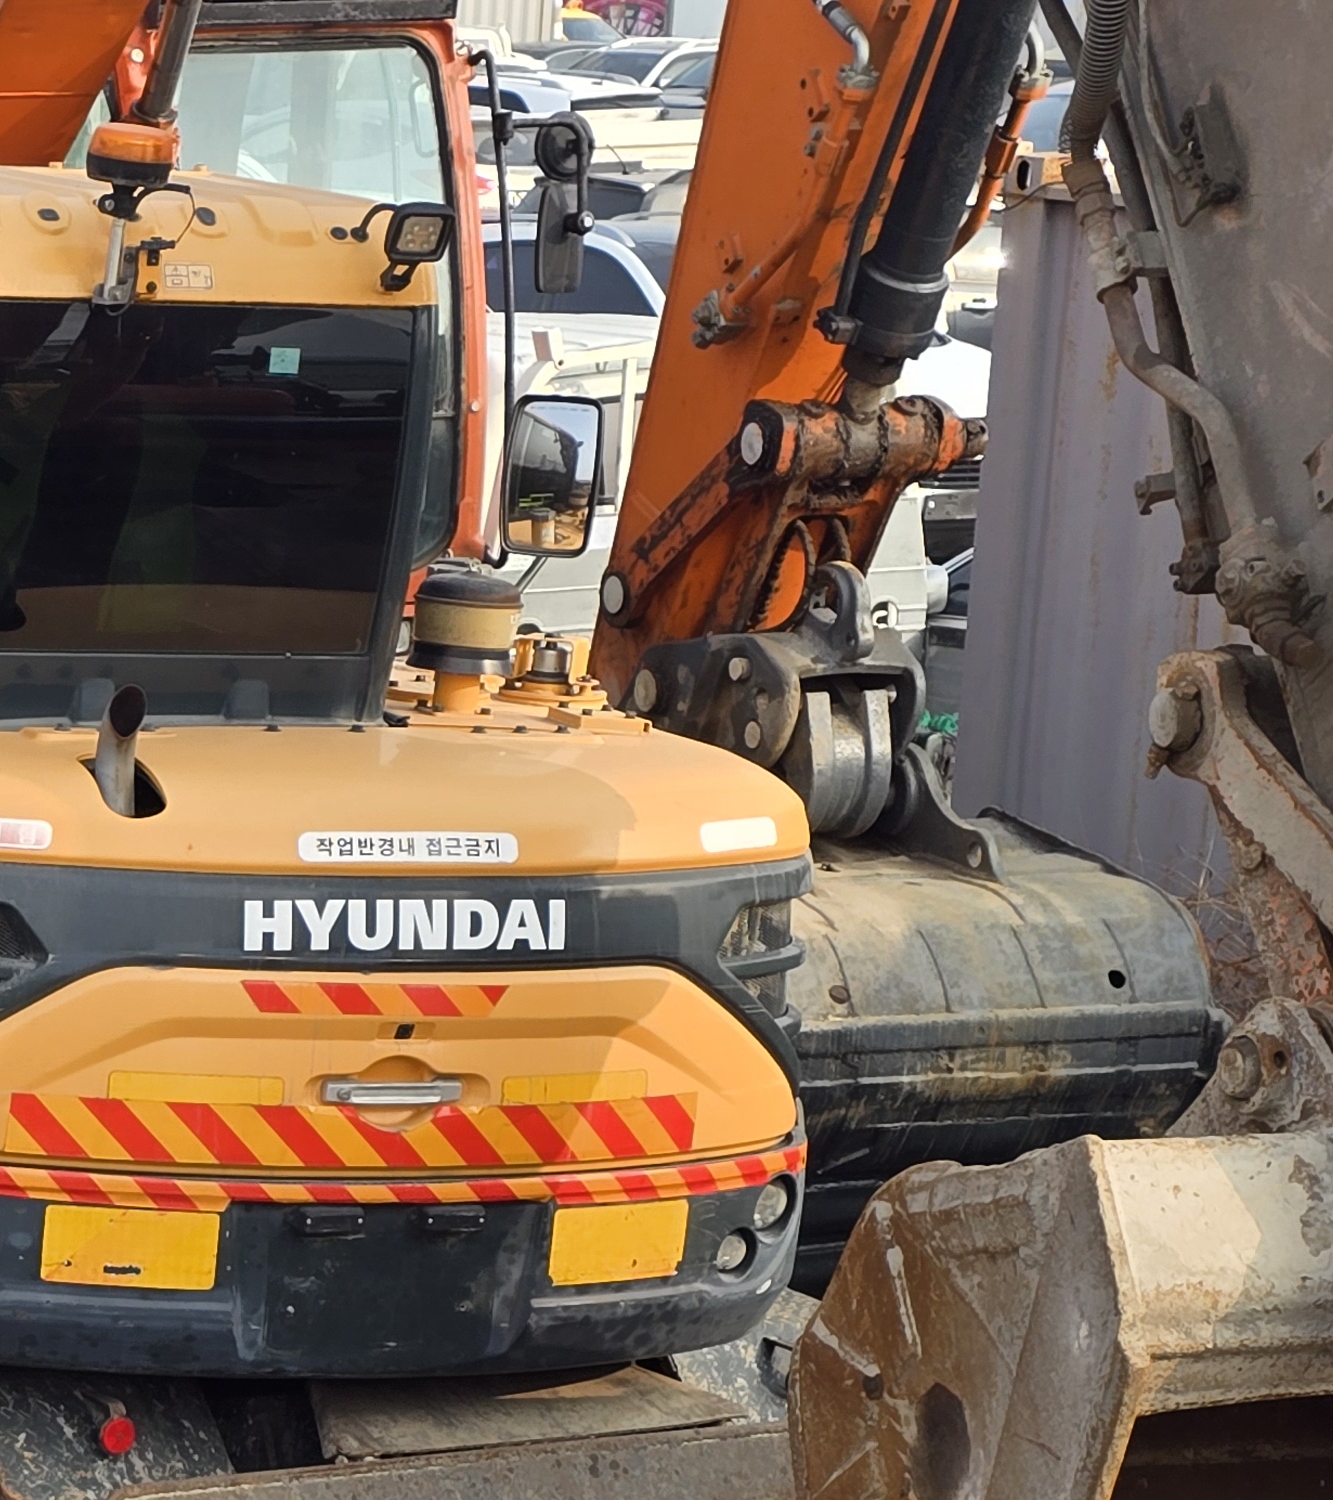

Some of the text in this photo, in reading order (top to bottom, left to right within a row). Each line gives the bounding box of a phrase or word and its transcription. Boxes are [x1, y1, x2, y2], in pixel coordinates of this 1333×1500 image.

[316, 838, 501, 857] 작업반경내 접근금지
[244, 899, 566, 950] HYUNDAI
